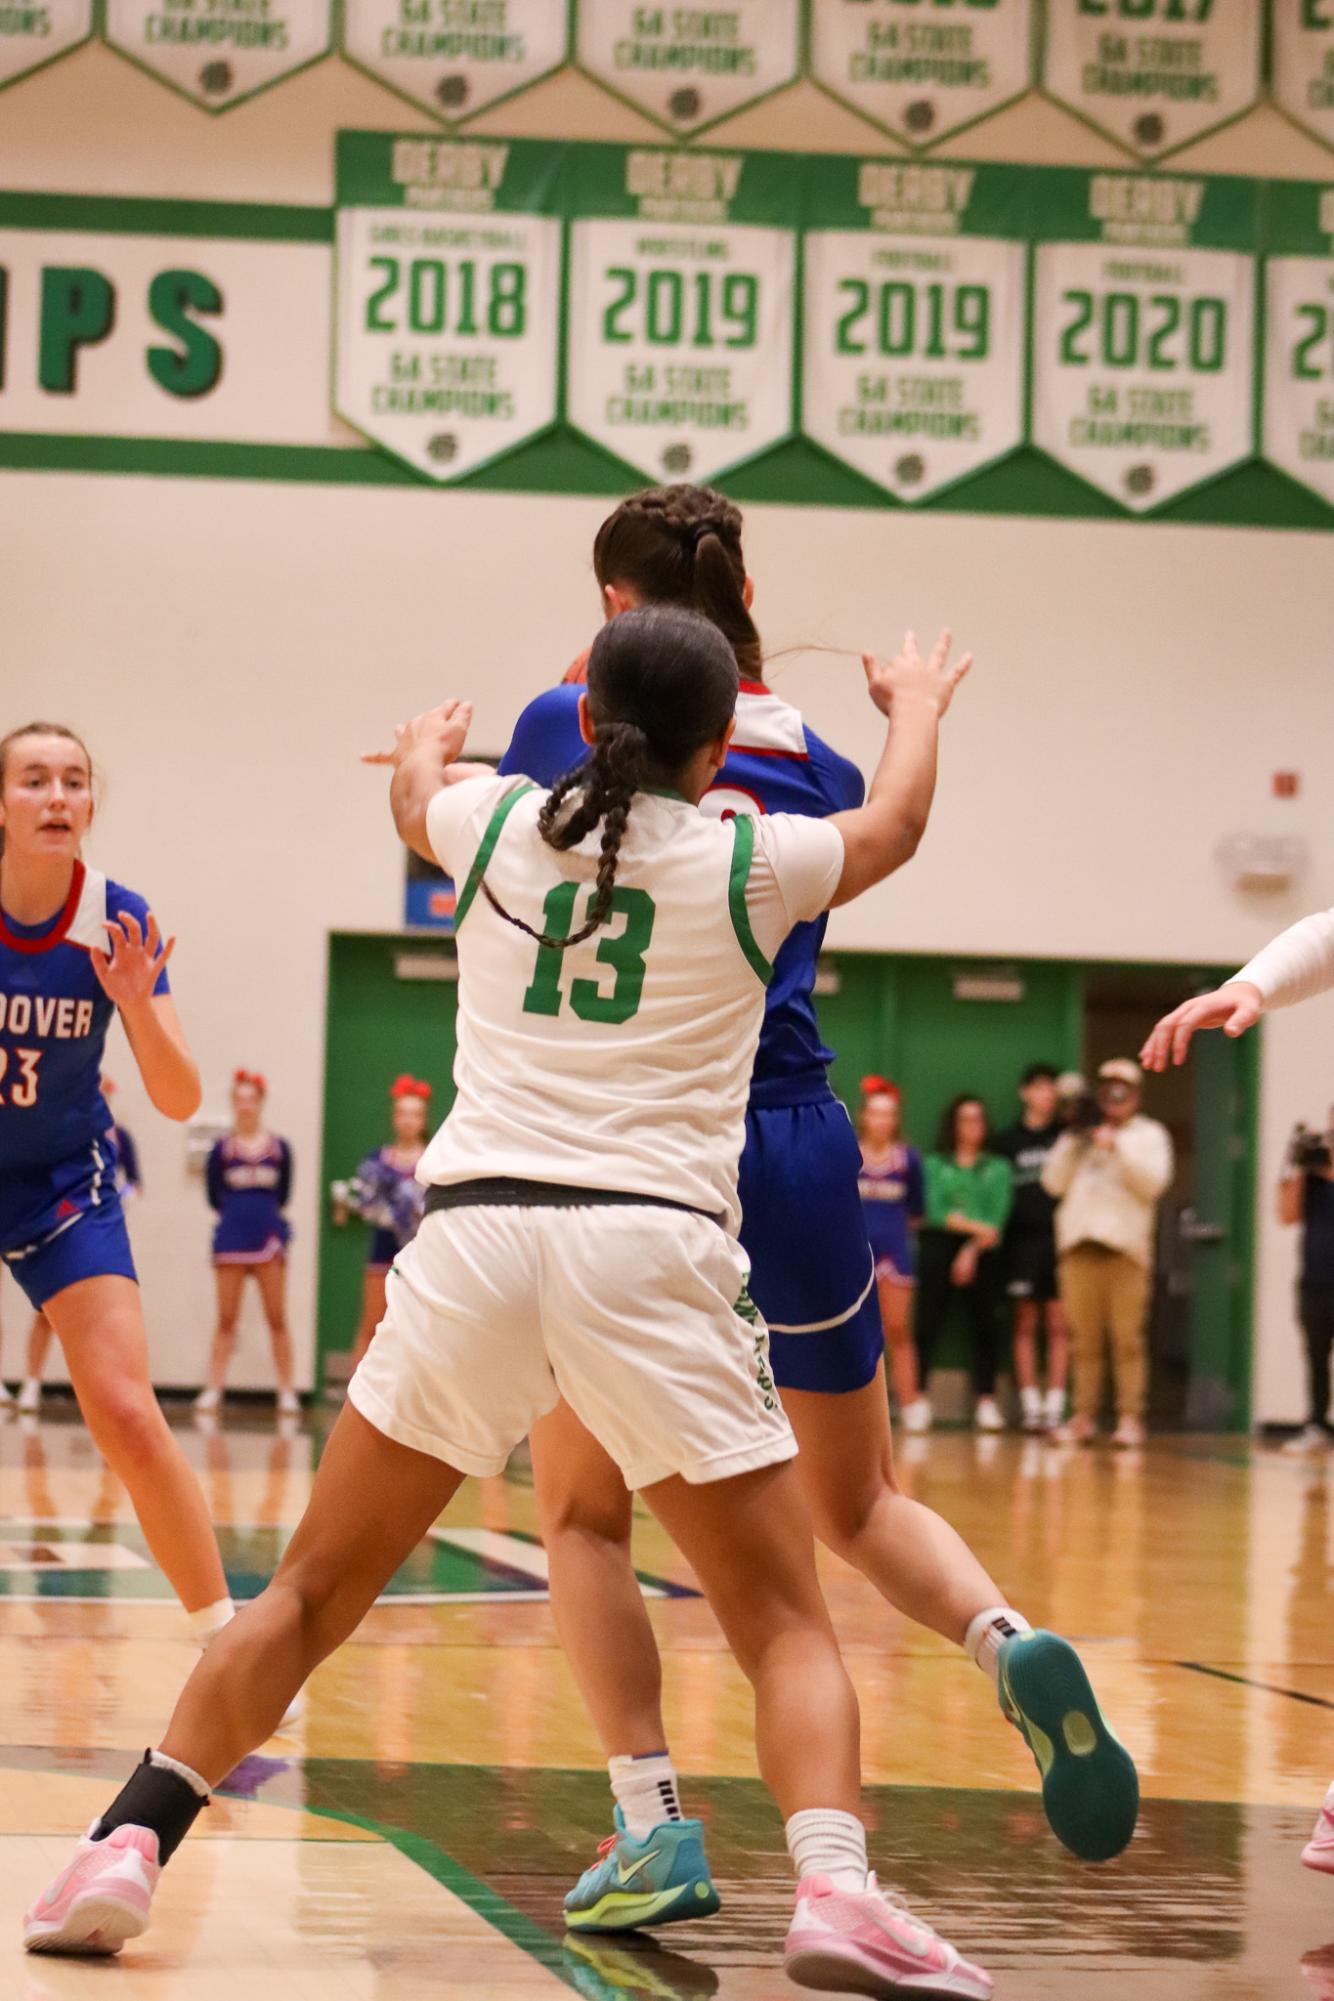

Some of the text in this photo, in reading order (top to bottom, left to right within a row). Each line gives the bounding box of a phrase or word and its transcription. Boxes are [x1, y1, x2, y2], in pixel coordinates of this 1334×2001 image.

[365, 254, 527, 338] 2018
[603, 266, 760, 348] 2019
[0, 264, 224, 402] PS
[834, 278, 990, 361] 2019
[1057, 289, 1226, 374] 2020
[430, 354, 496, 387] STATE
[664, 366, 732, 398] STATE
[371, 385, 515, 421] CHAMPIONS
[896, 377, 965, 411] STATE
[605, 396, 748, 433] CHAMPIONS
[837, 407, 983, 445] CHAMPIONS
[1068, 416, 1210, 454] CHAMPIONS
[523, 880, 657, 1025] 13
